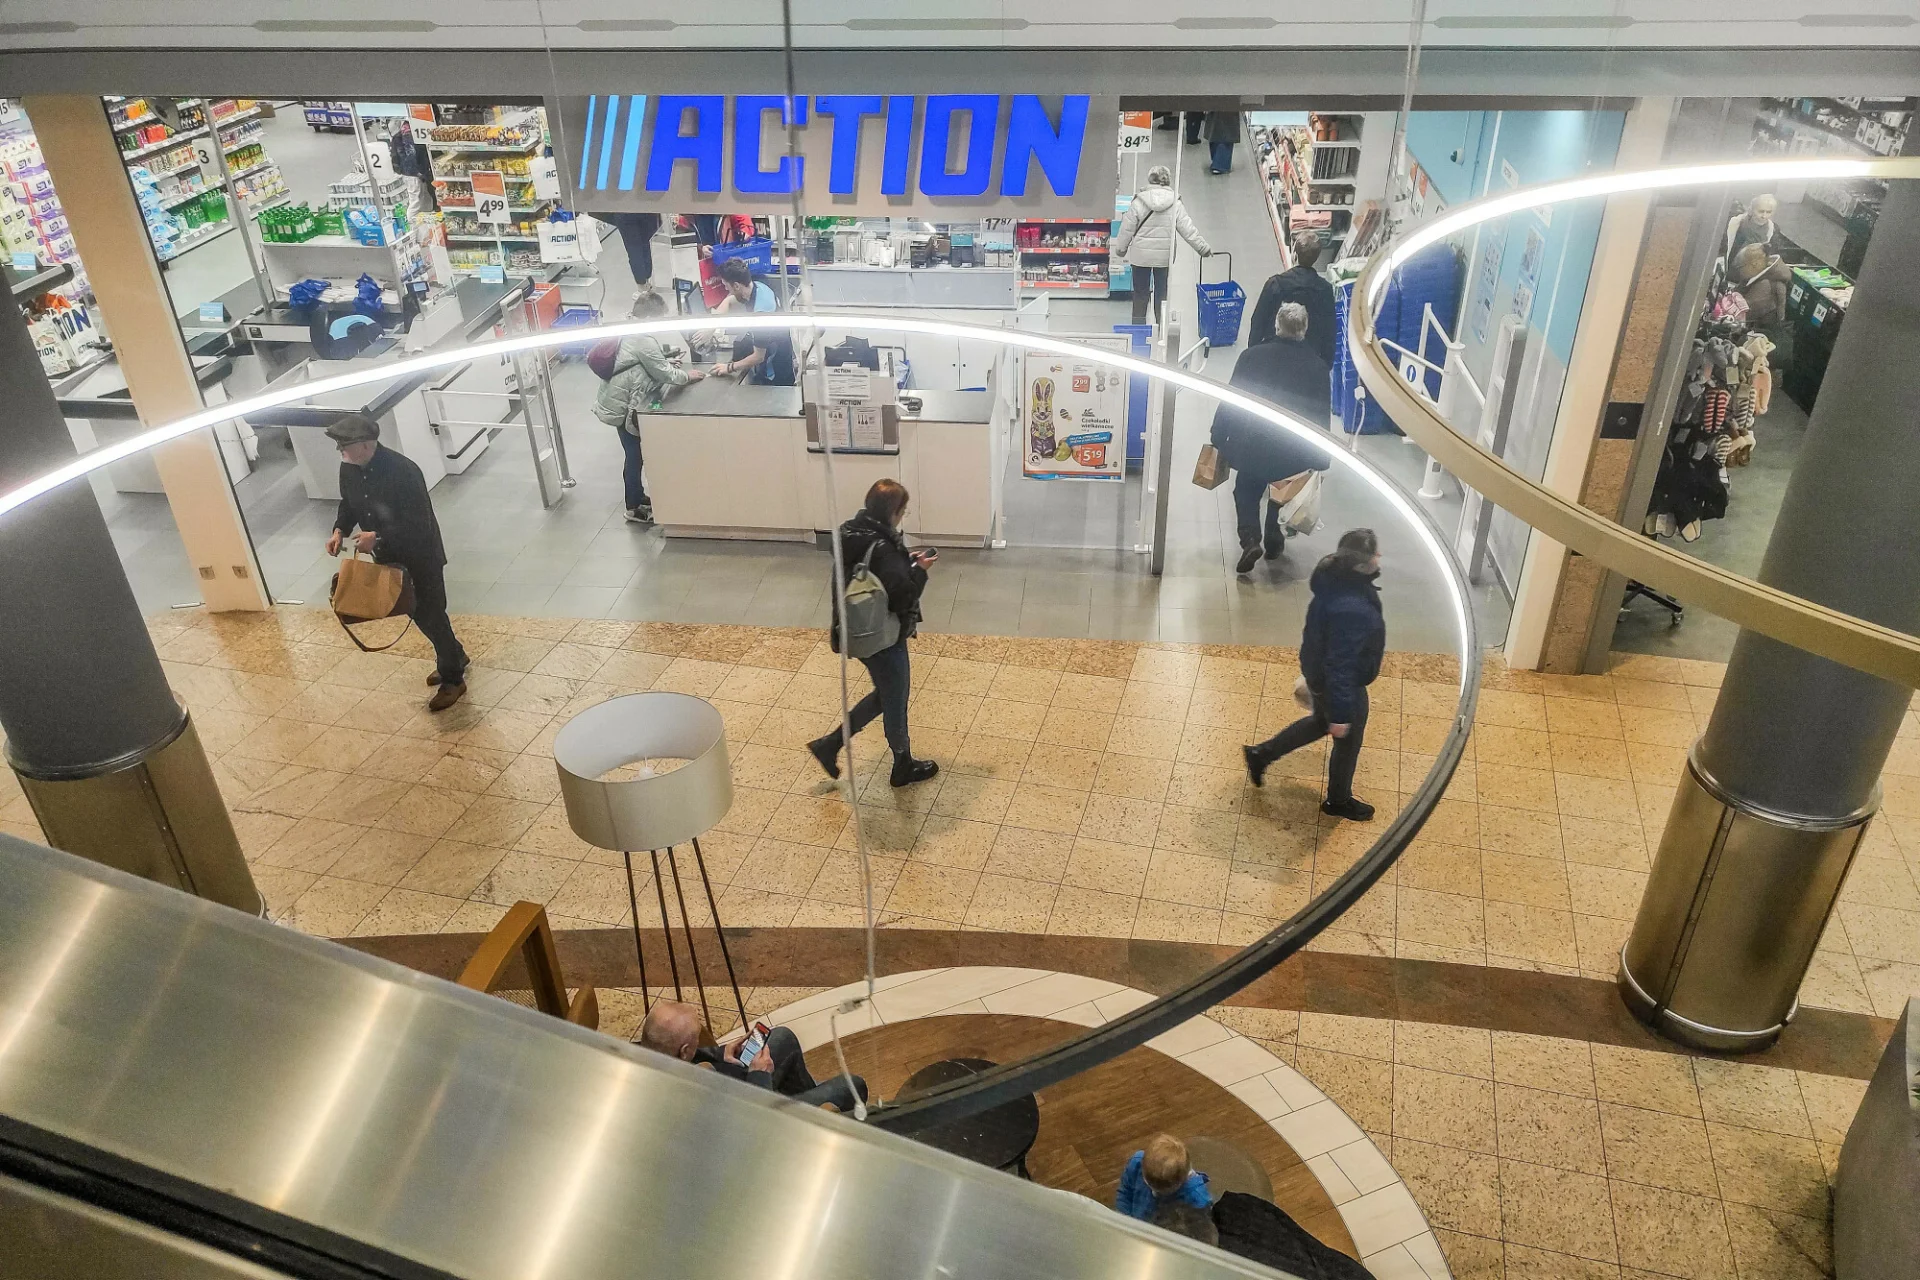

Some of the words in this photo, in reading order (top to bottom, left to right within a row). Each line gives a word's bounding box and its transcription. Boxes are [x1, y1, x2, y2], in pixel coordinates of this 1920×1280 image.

[645, 95, 1090, 197] ACTION
[198, 149, 210, 164] 3
[371, 153, 382, 168] 2
[479, 199, 504, 217] 499
[551, 234, 577, 243] ACTION
[1083, 450, 1102, 462] 519
